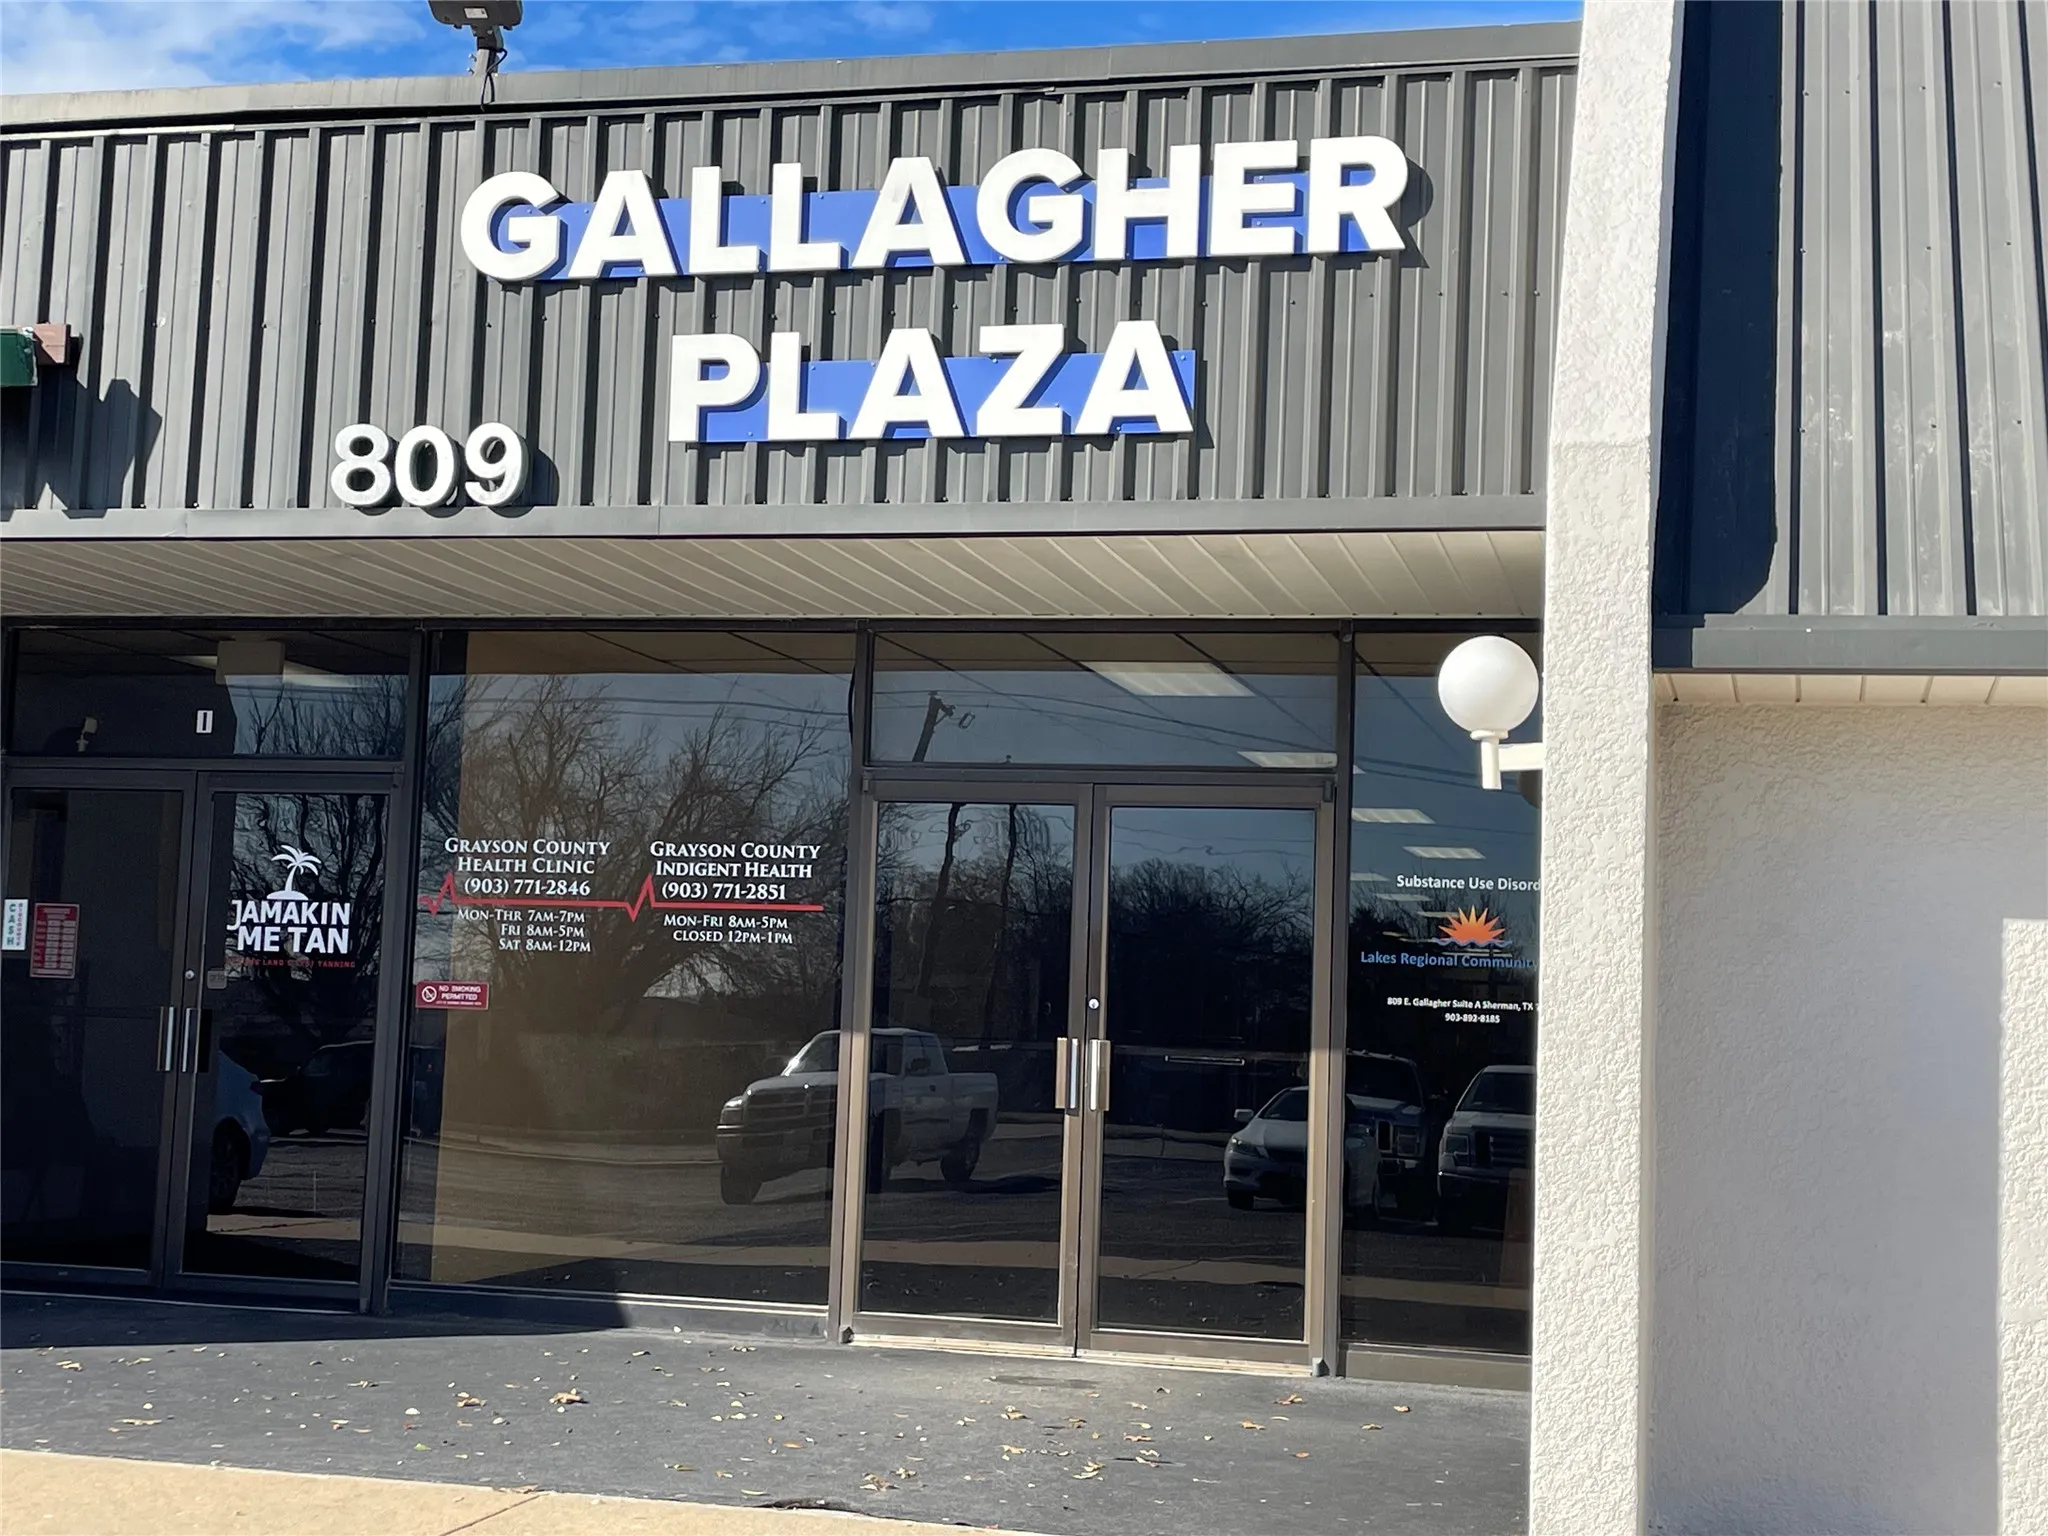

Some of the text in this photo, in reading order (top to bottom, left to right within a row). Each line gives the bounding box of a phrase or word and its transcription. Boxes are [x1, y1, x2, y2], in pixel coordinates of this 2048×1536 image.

[460, 134, 1408, 283] GALLAGHER
[668, 320, 1195, 444] PLAZA
[330, 423, 526, 508] 809
[445, 838, 610, 855] GRAYSON COUNTY
[650, 841, 821, 859] GRAYSON COUNTY
[458, 857, 595, 874] HEALTH CLINIC
[656, 861, 812, 878] INDIGENT HEALTH
[464, 878, 591, 896] (903) 771-2846
[662, 882, 786, 900] (903) 771-2851
[1396, 875, 1465, 889] Substance
[1468, 877, 1494, 890] Use
[226, 899, 351, 931] JAMAKIN
[457, 908, 585, 923] MON-THR 7AM-7PM
[663, 914, 788, 929] MON-FRI 8AM-5PM
[501, 924, 584, 938] FRI 8AM-5PM
[673, 930, 793, 944] CLOSED 12PM-1PM
[237, 926, 349, 954] ME TAN
[499, 938, 591, 952] SAT 8AM-12PM
[1361, 951, 1397, 964] Lakes
[1400, 952, 1458, 968] Regional
[451, 985, 482, 993] SMOKING
[1387, 997, 1403, 1006] 809
[1404, 998, 1412, 1006] E.
[1413, 998, 1451, 1009] Gallagher
[1452, 999, 1473, 1009] Suite
[1474, 1000, 1482, 1009] A
[1482, 1000, 1521, 1011] Sherman,
[1522, 1002, 1534, 1011] TX
